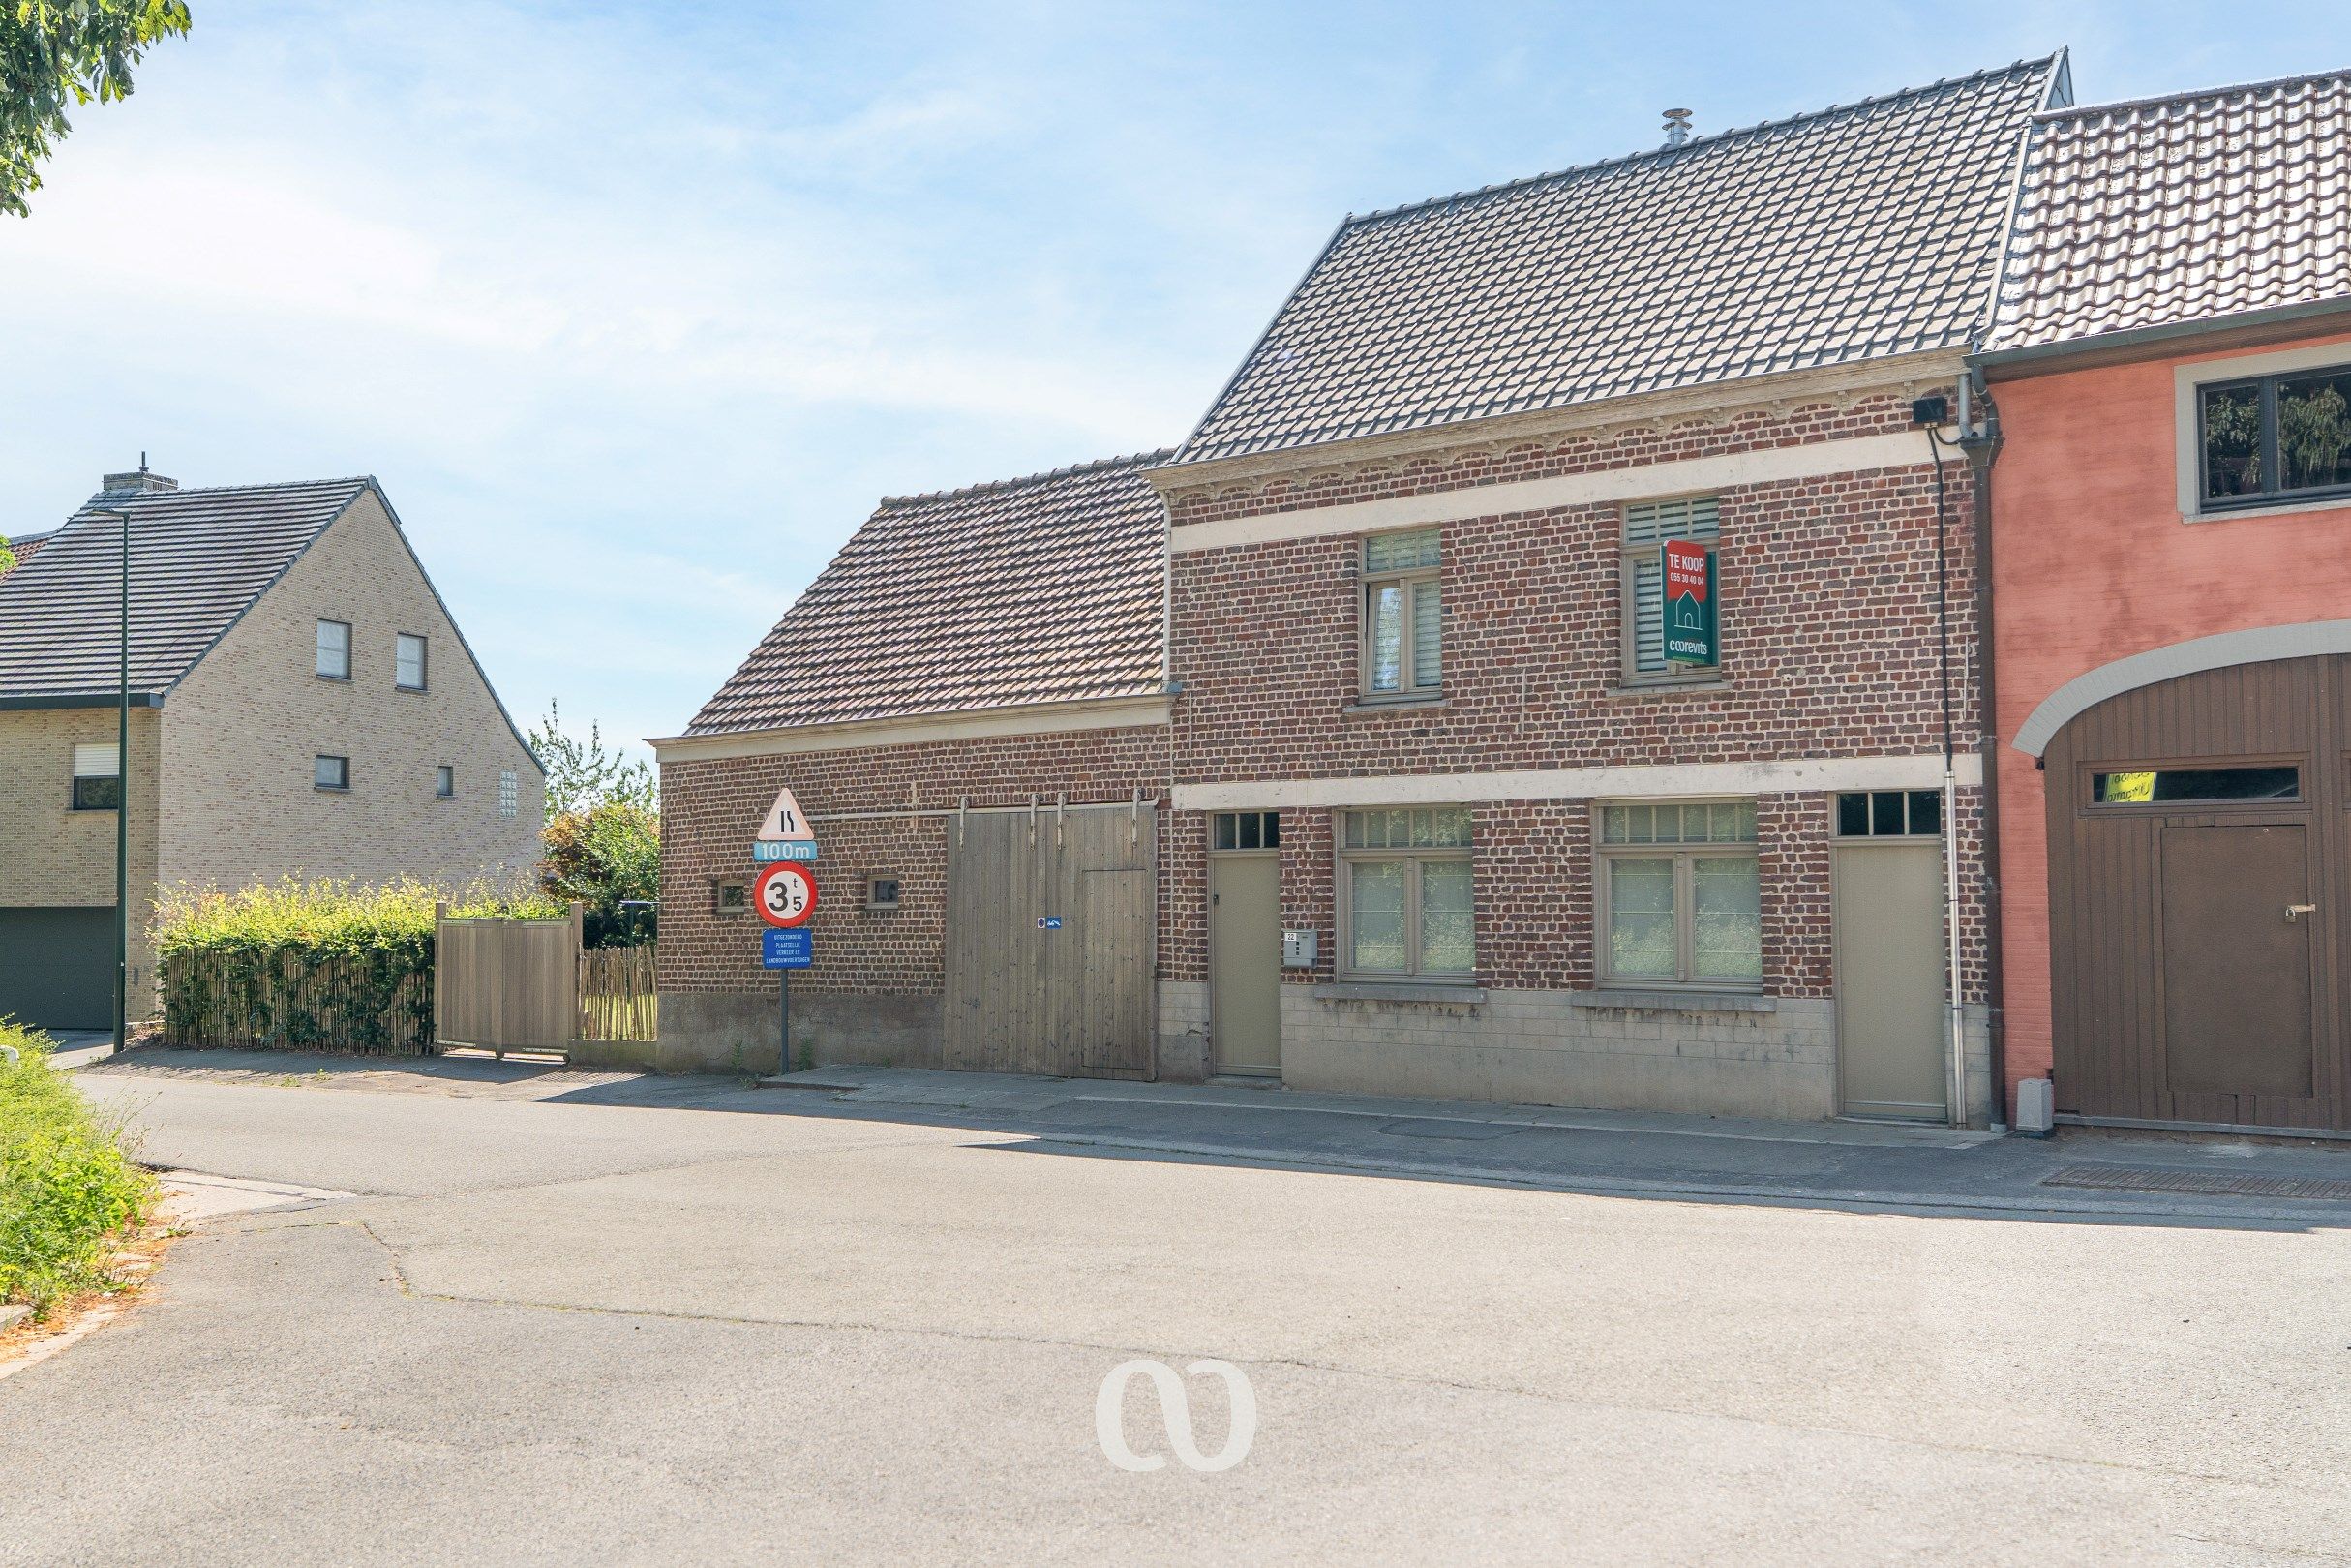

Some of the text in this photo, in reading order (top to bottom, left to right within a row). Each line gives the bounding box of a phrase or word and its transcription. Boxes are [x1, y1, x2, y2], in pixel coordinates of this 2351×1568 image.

[1668, 553, 1704, 572] TE KOOP
[1670, 572, 1681, 582] 055
[1669, 639, 1707, 655] coorevits
[762, 842, 810, 859] 100m
